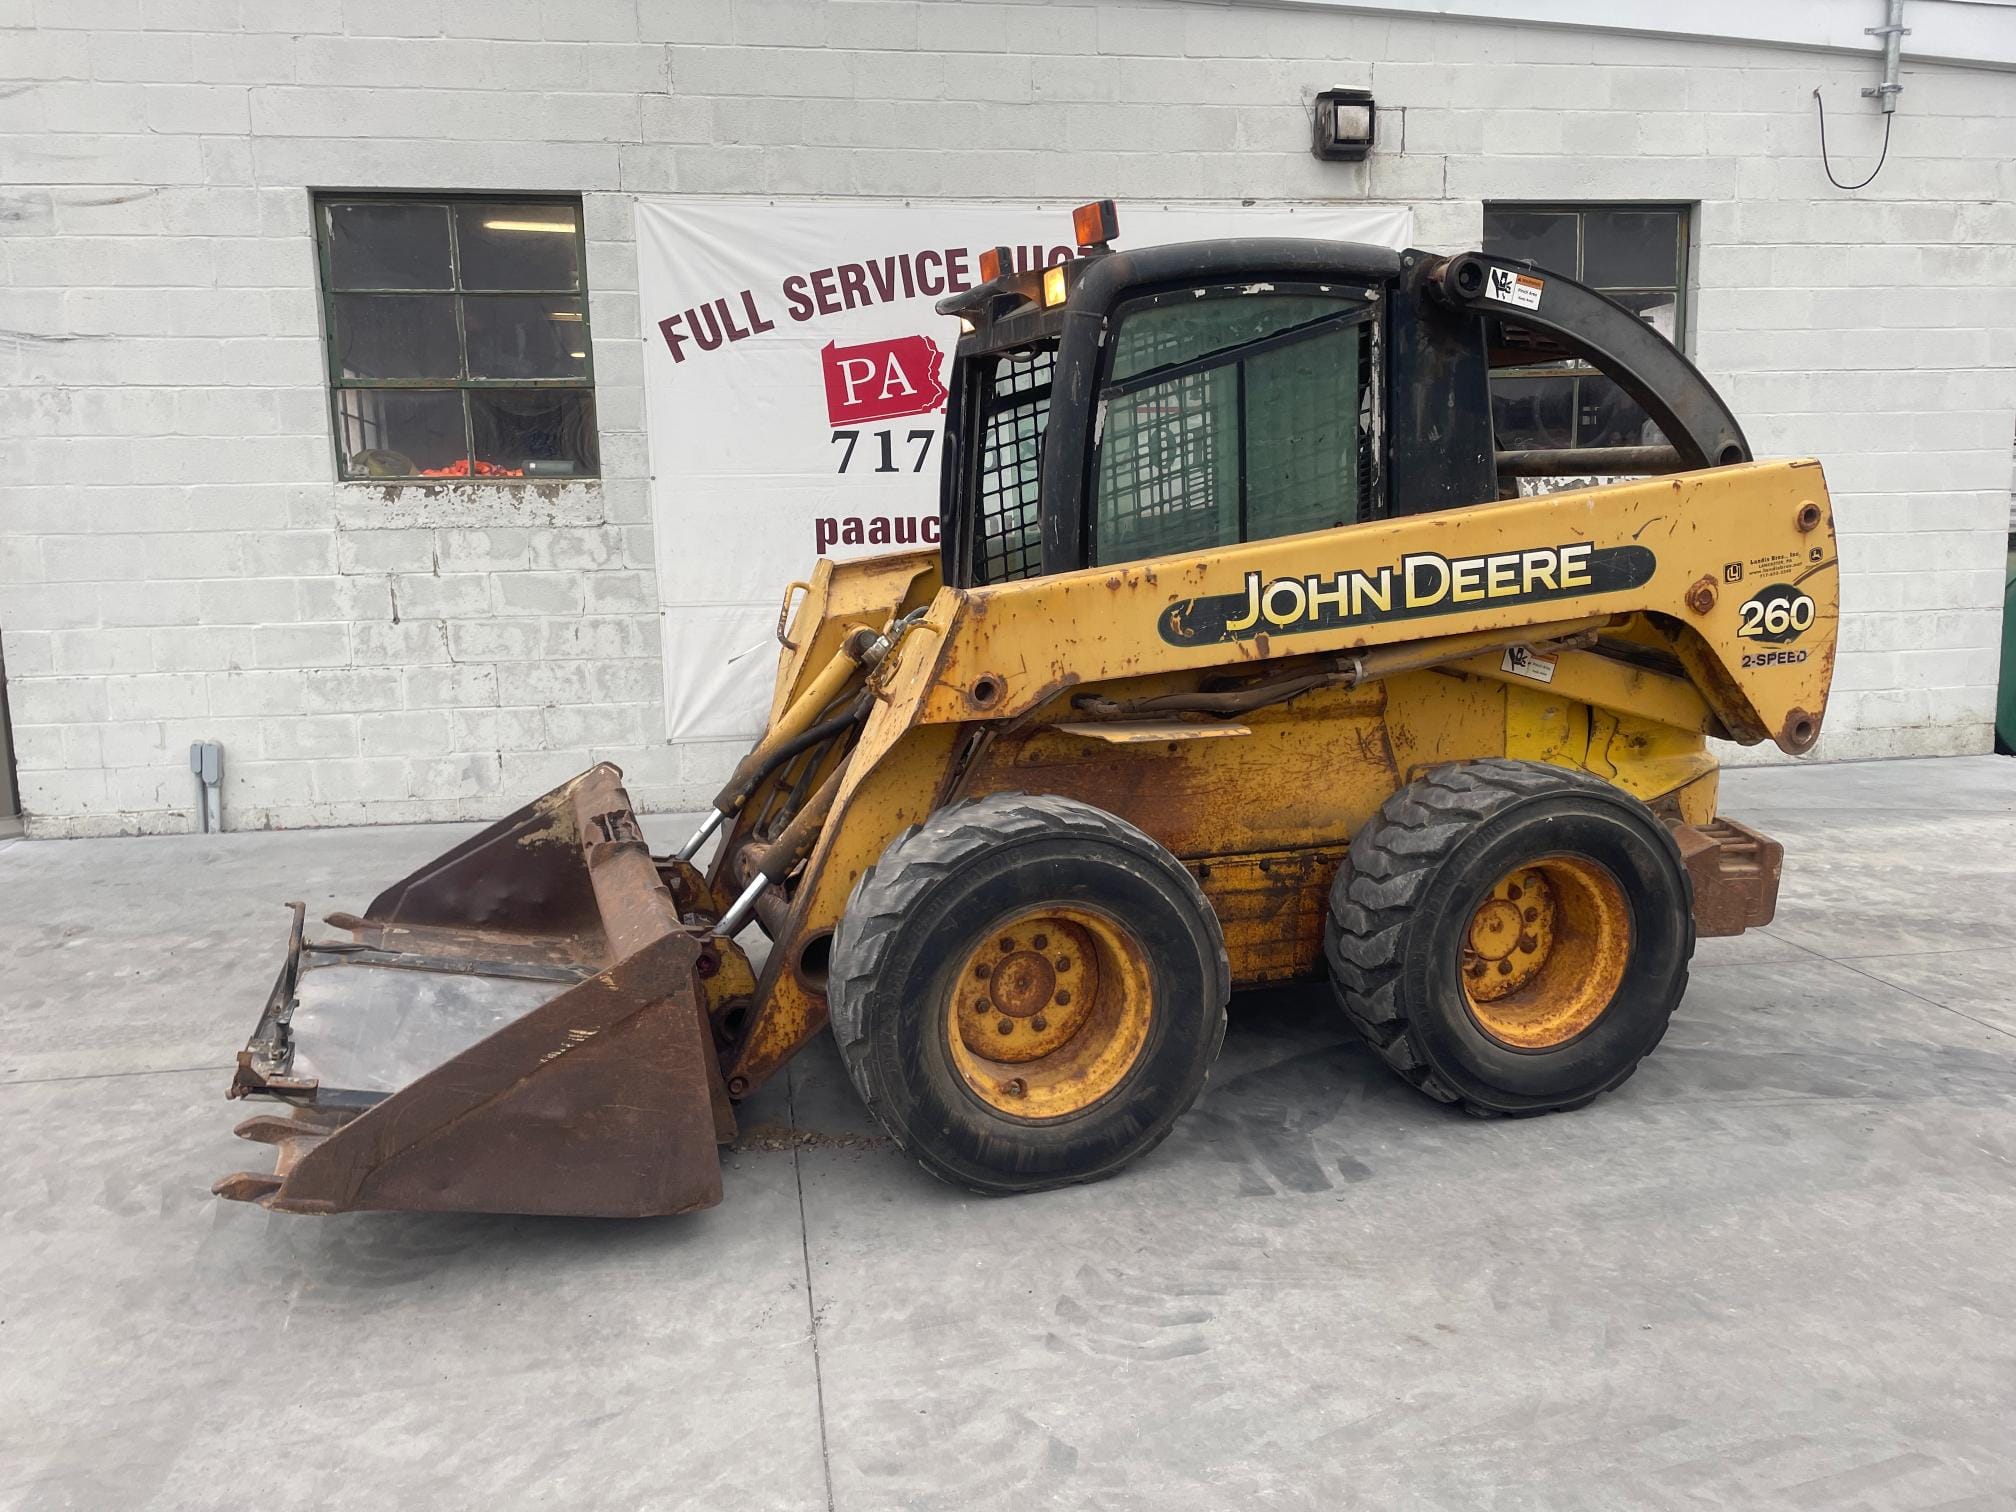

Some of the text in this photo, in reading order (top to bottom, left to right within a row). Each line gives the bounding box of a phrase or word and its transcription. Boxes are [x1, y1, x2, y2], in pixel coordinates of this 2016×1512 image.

[658, 247, 971, 363] FULL SERVICE
[836, 351, 918, 407] PA
[830, 429, 935, 474] 717
[1225, 543, 1594, 632] JOHN DEERE
[1737, 594, 1815, 638] 260
[1742, 650, 1807, 668] 2-SPEED
